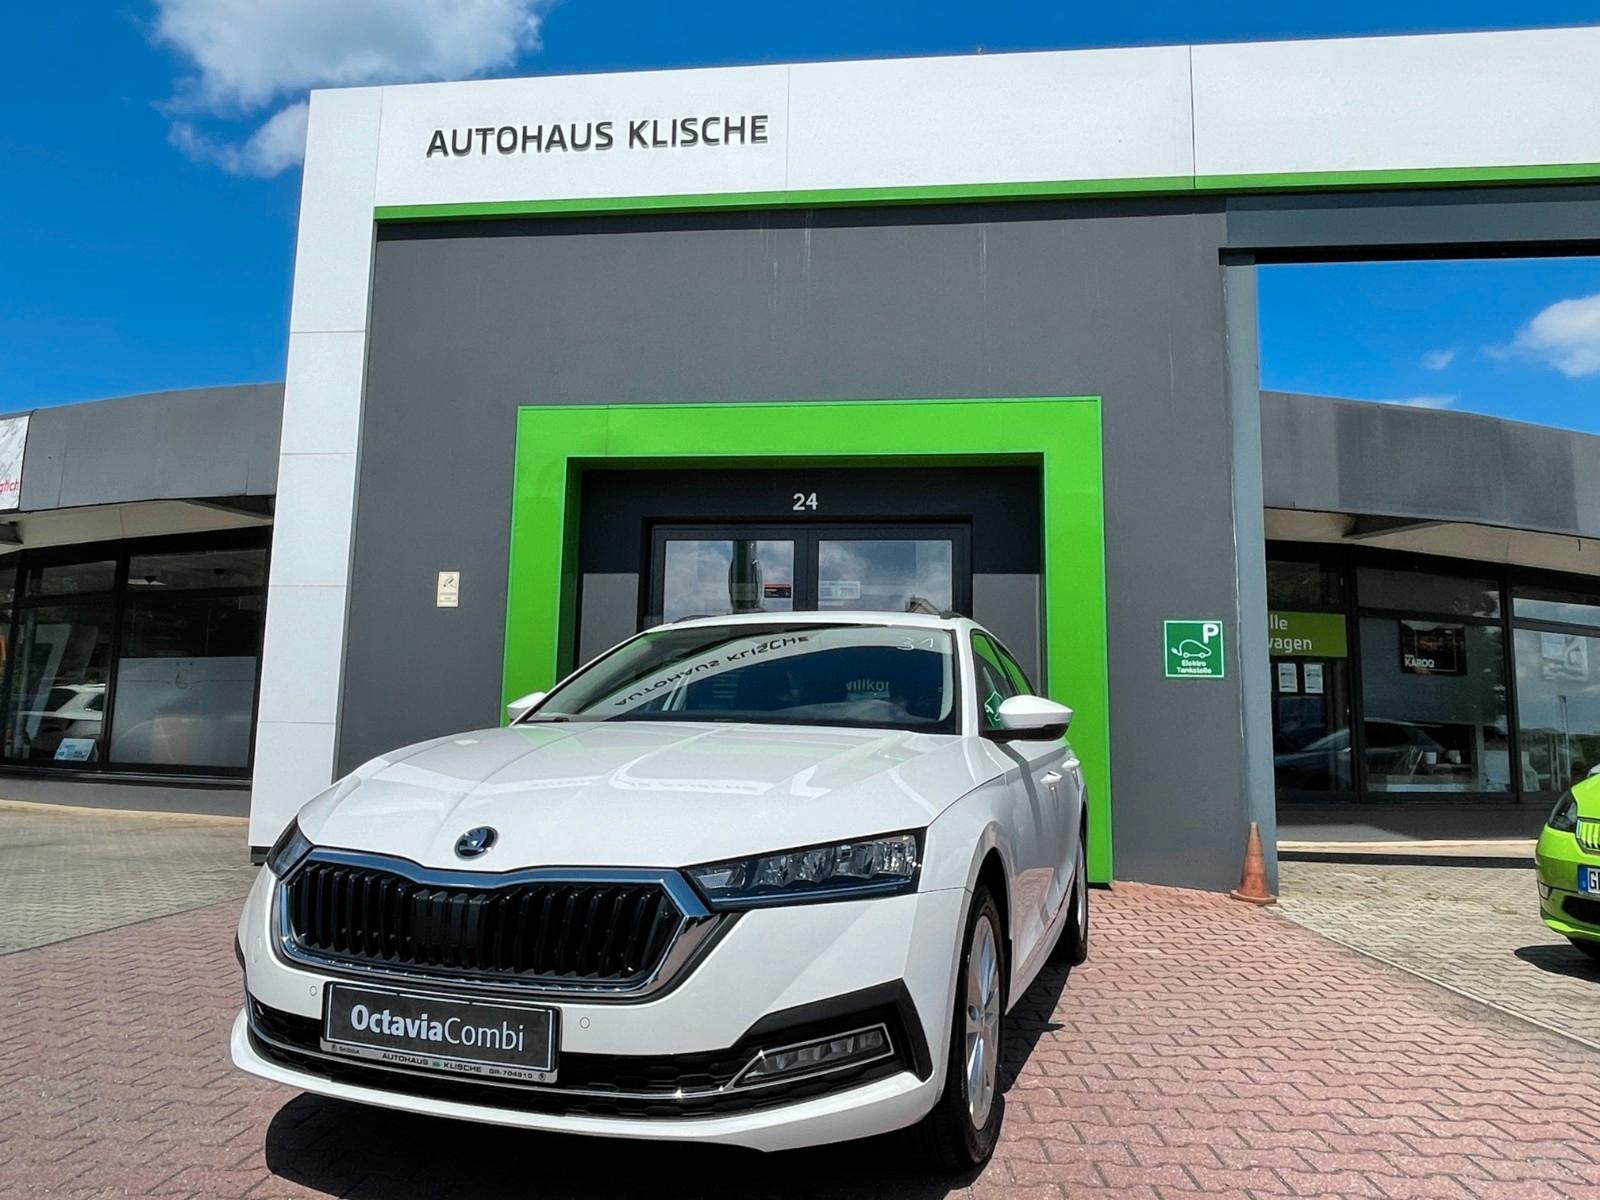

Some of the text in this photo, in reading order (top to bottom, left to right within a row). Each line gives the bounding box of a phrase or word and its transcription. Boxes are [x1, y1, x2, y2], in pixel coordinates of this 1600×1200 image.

[426, 115, 769, 158] AUTOHAUS KLISCHE
[793, 493, 818, 510] 24
[1203, 624, 1219, 644] P
[1589, 871, 1600, 890] G
[351, 1004, 524, 1051] OctaviaCombi
[382, 1052, 429, 1066] AUTOHAUS
[443, 1061, 482, 1073] KLISCHE
